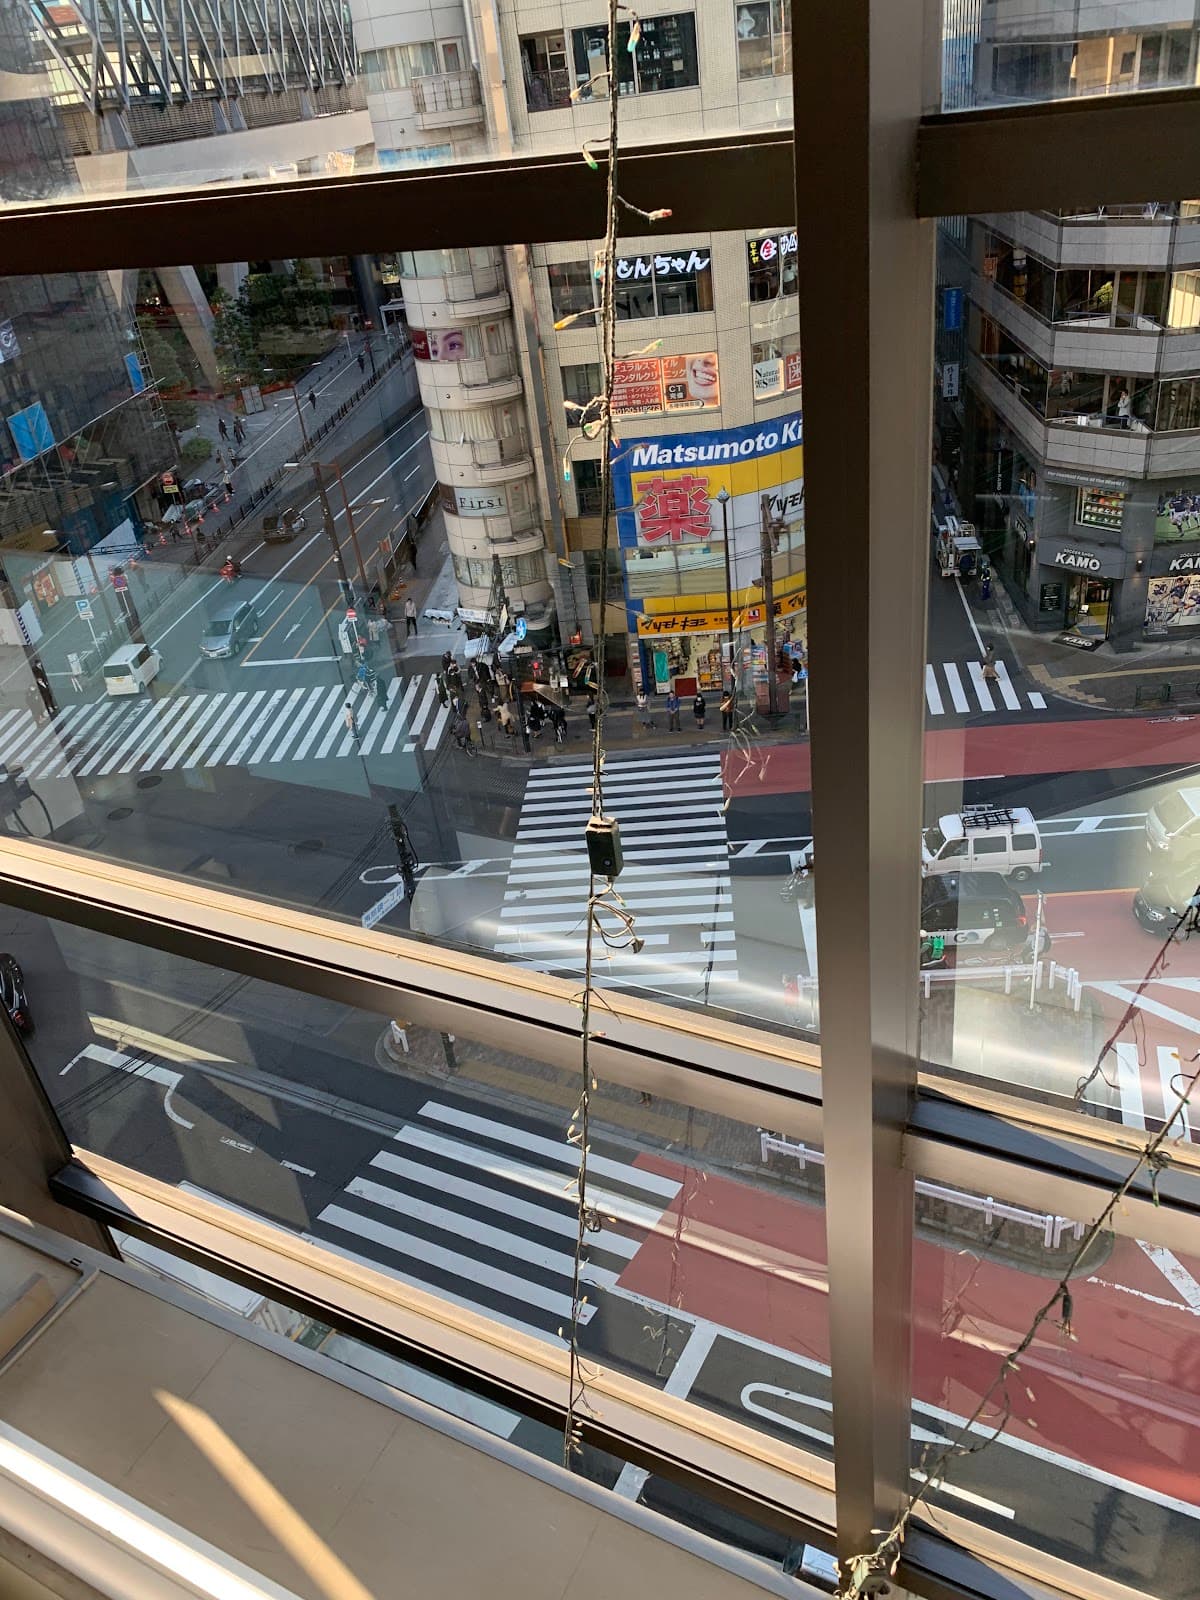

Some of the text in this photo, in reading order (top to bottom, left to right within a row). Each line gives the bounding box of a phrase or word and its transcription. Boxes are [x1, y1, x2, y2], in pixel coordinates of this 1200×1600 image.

[616, 250, 710, 279] とんちゃん
[613, 359, 679, 374] チュラルスマイル
[668, 385, 683, 393] CT
[632, 432, 779, 466] Matsumoto
[459, 496, 504, 509] First
[636, 474, 713, 542] 薬
[1055, 552, 1100, 571] KAMO
